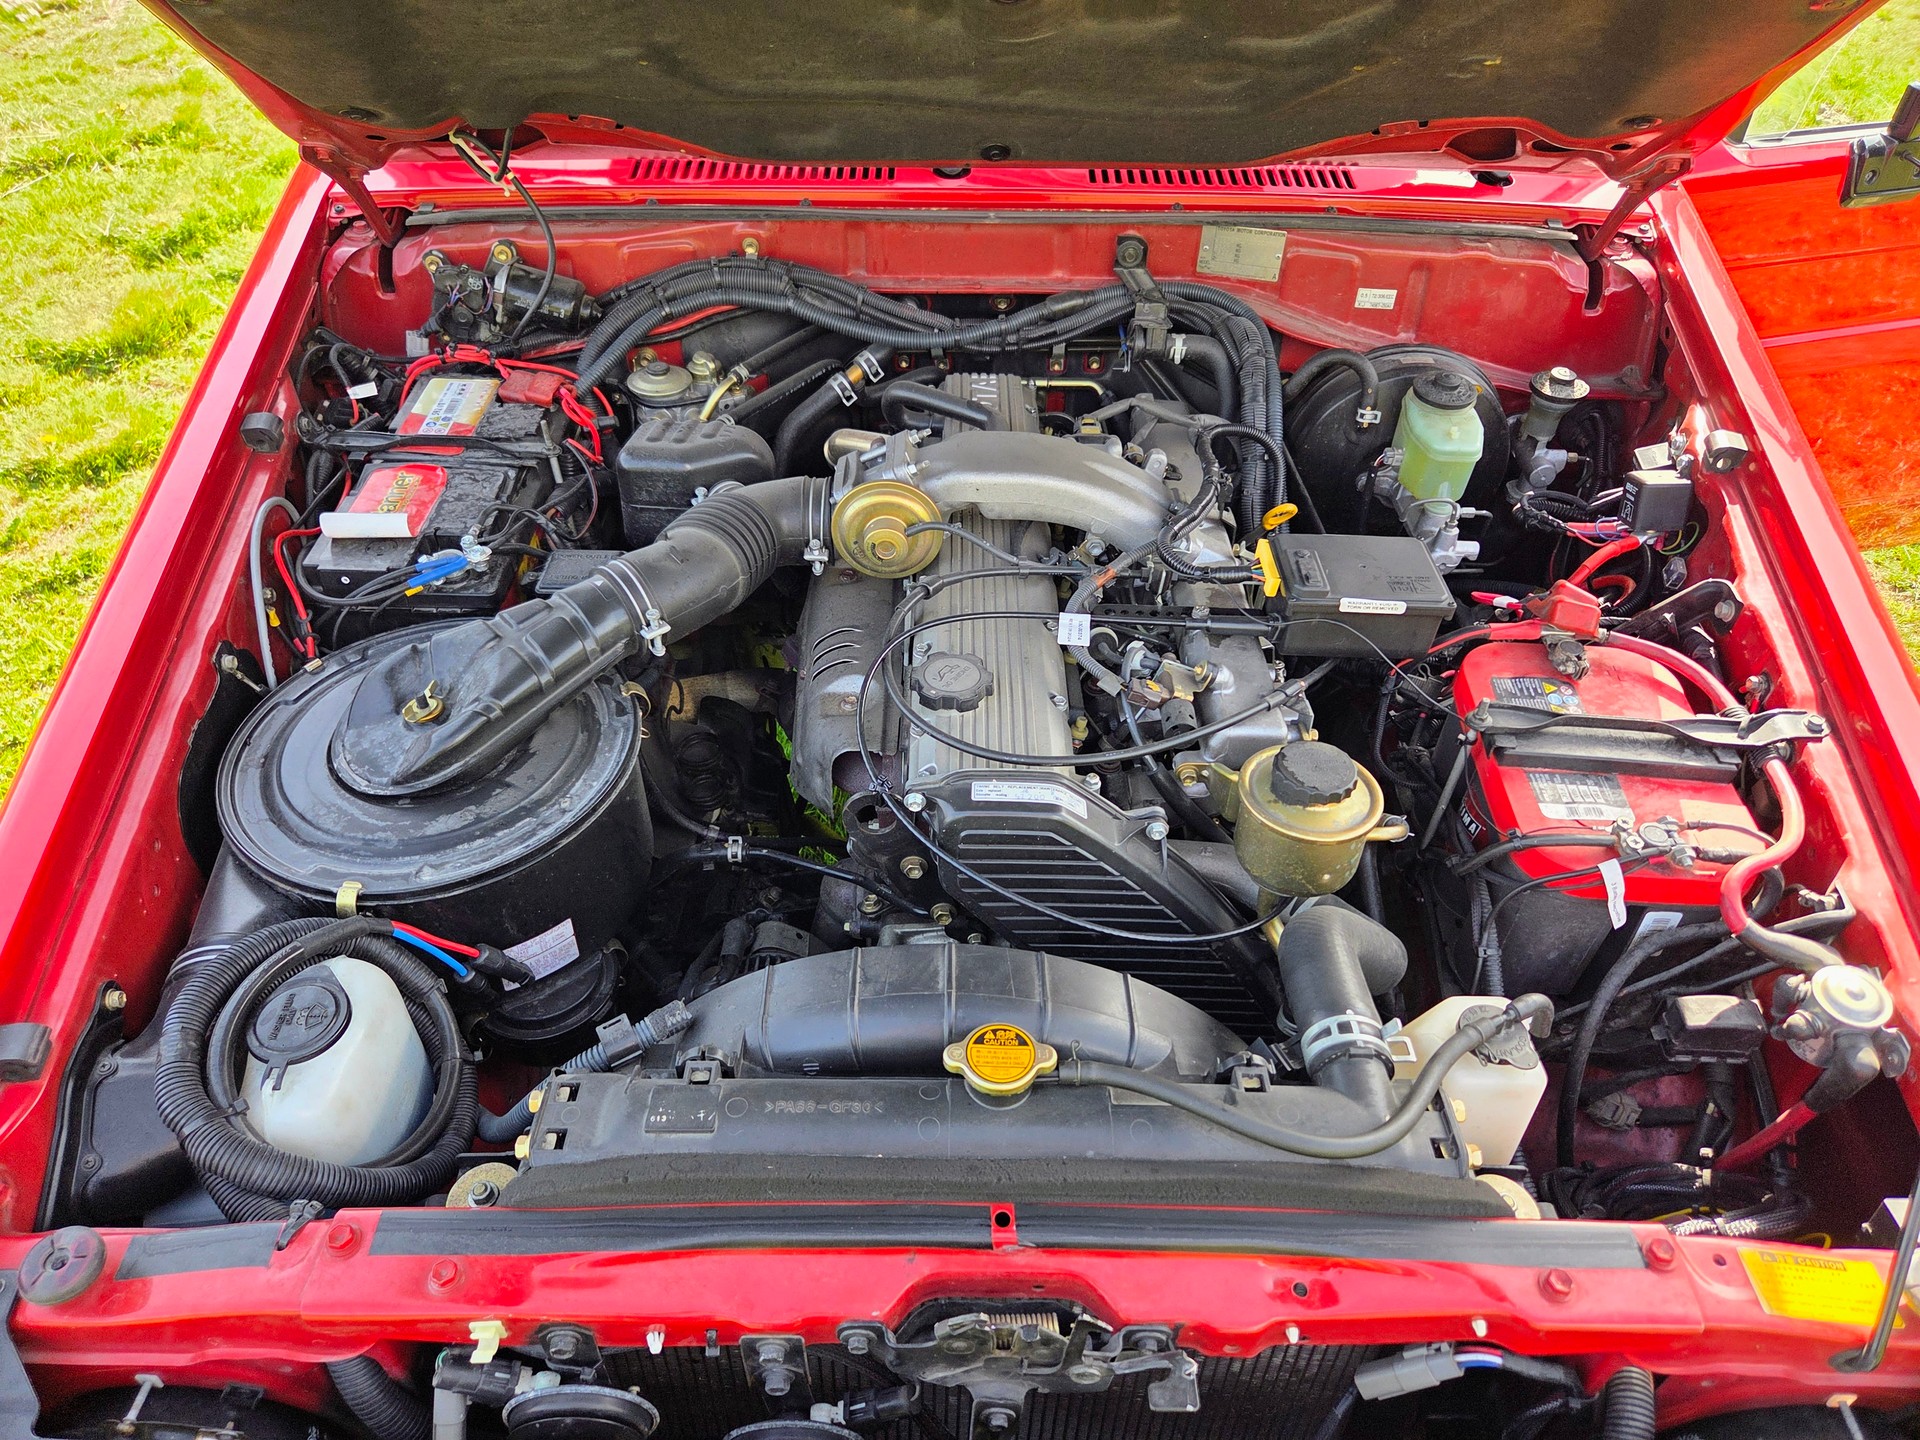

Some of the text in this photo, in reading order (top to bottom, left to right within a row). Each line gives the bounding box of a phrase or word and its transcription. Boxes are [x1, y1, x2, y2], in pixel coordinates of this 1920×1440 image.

[379, 471, 413, 512] anner
[1460, 806, 1477, 835] IMA
[1495, 1035, 1527, 1058] COOLANT
[1797, 1256, 1846, 1271] CAUTION
